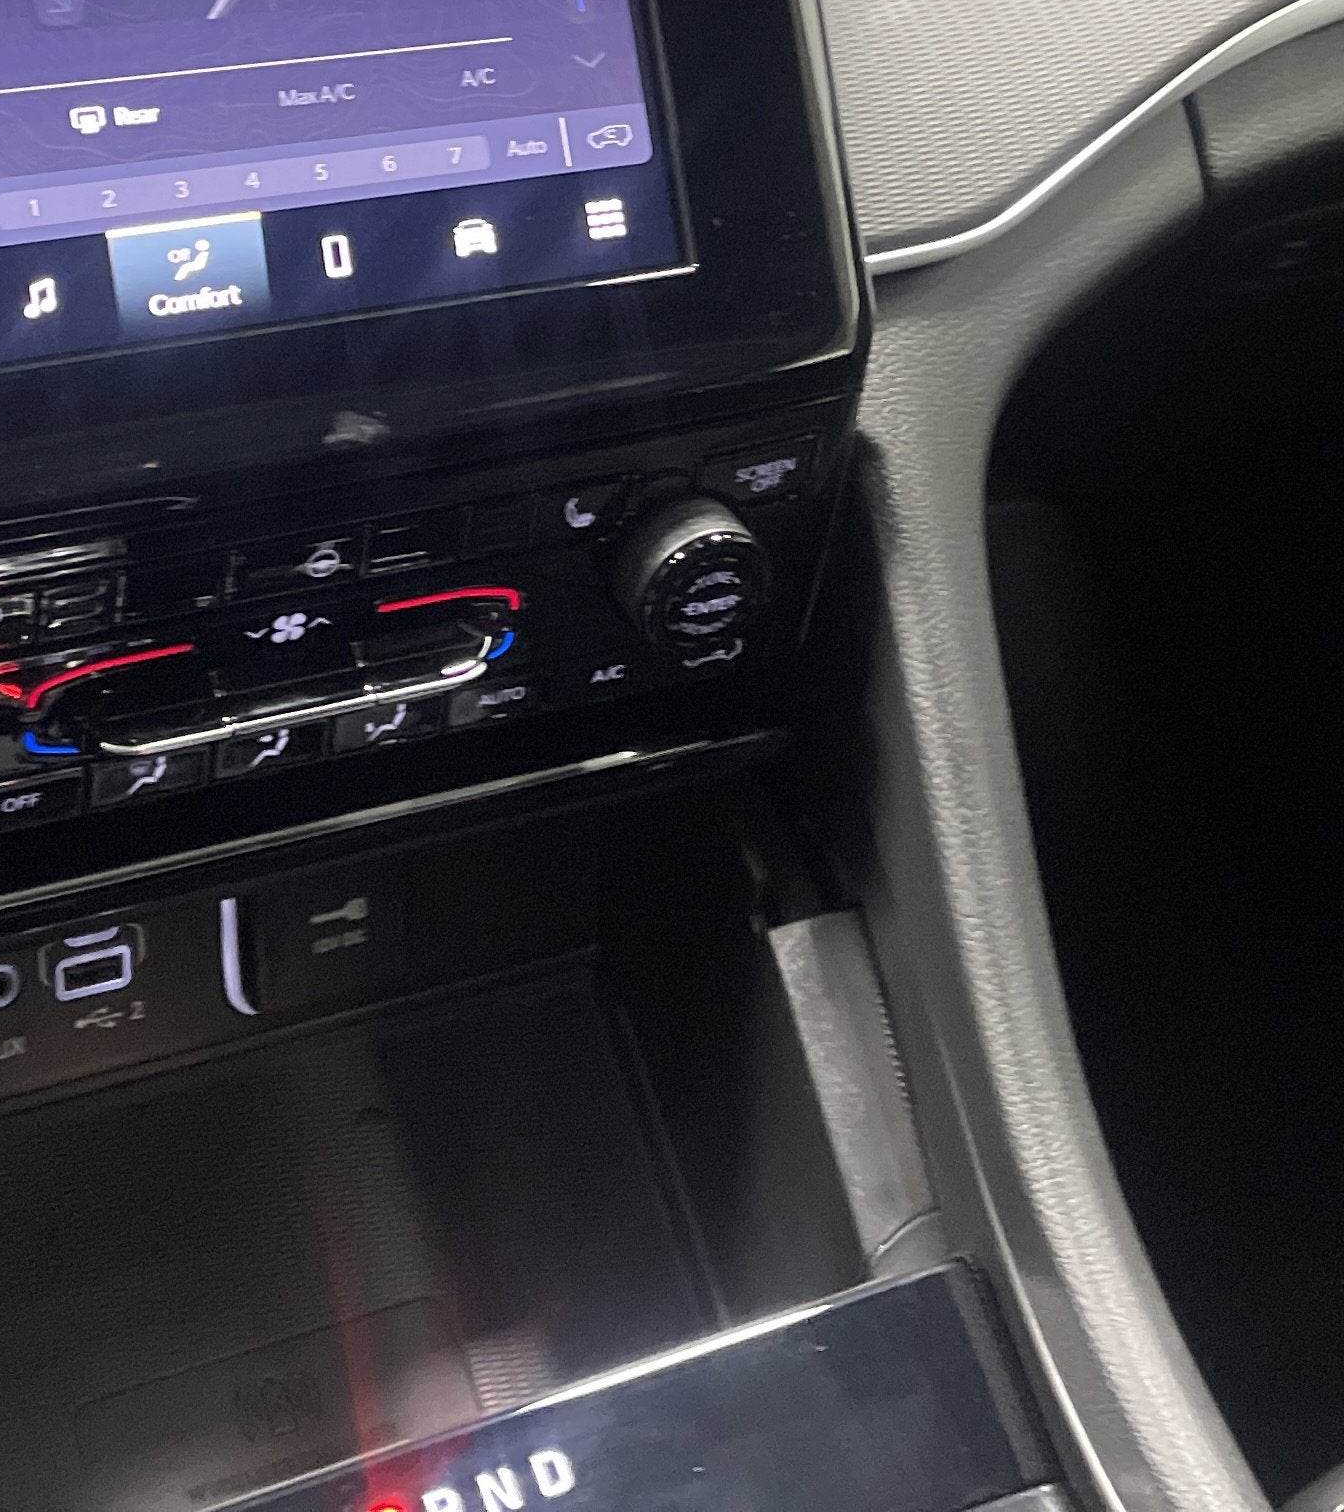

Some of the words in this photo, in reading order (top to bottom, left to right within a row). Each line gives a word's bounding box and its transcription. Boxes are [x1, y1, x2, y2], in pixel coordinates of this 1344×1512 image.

[460, 68, 497, 87] A/C
[278, 90, 317, 108] Max
[320, 83, 356, 102] A/C
[507, 139, 548, 157] Auto
[28, 199, 41, 217] 1
[101, 190, 118, 208] 2
[174, 181, 190, 199] 3
[244, 172, 260, 189] 4
[313, 164, 329, 181] 5
[382, 156, 398, 173] 6
[446, 147, 462, 164] 7
[148, 285, 243, 317] Comfort
[0, 792, 41, 813] OFF
[129, 1001, 145, 1022] 2
[475, 1465, 524, 1511] N
[528, 1449, 575, 1498] D
